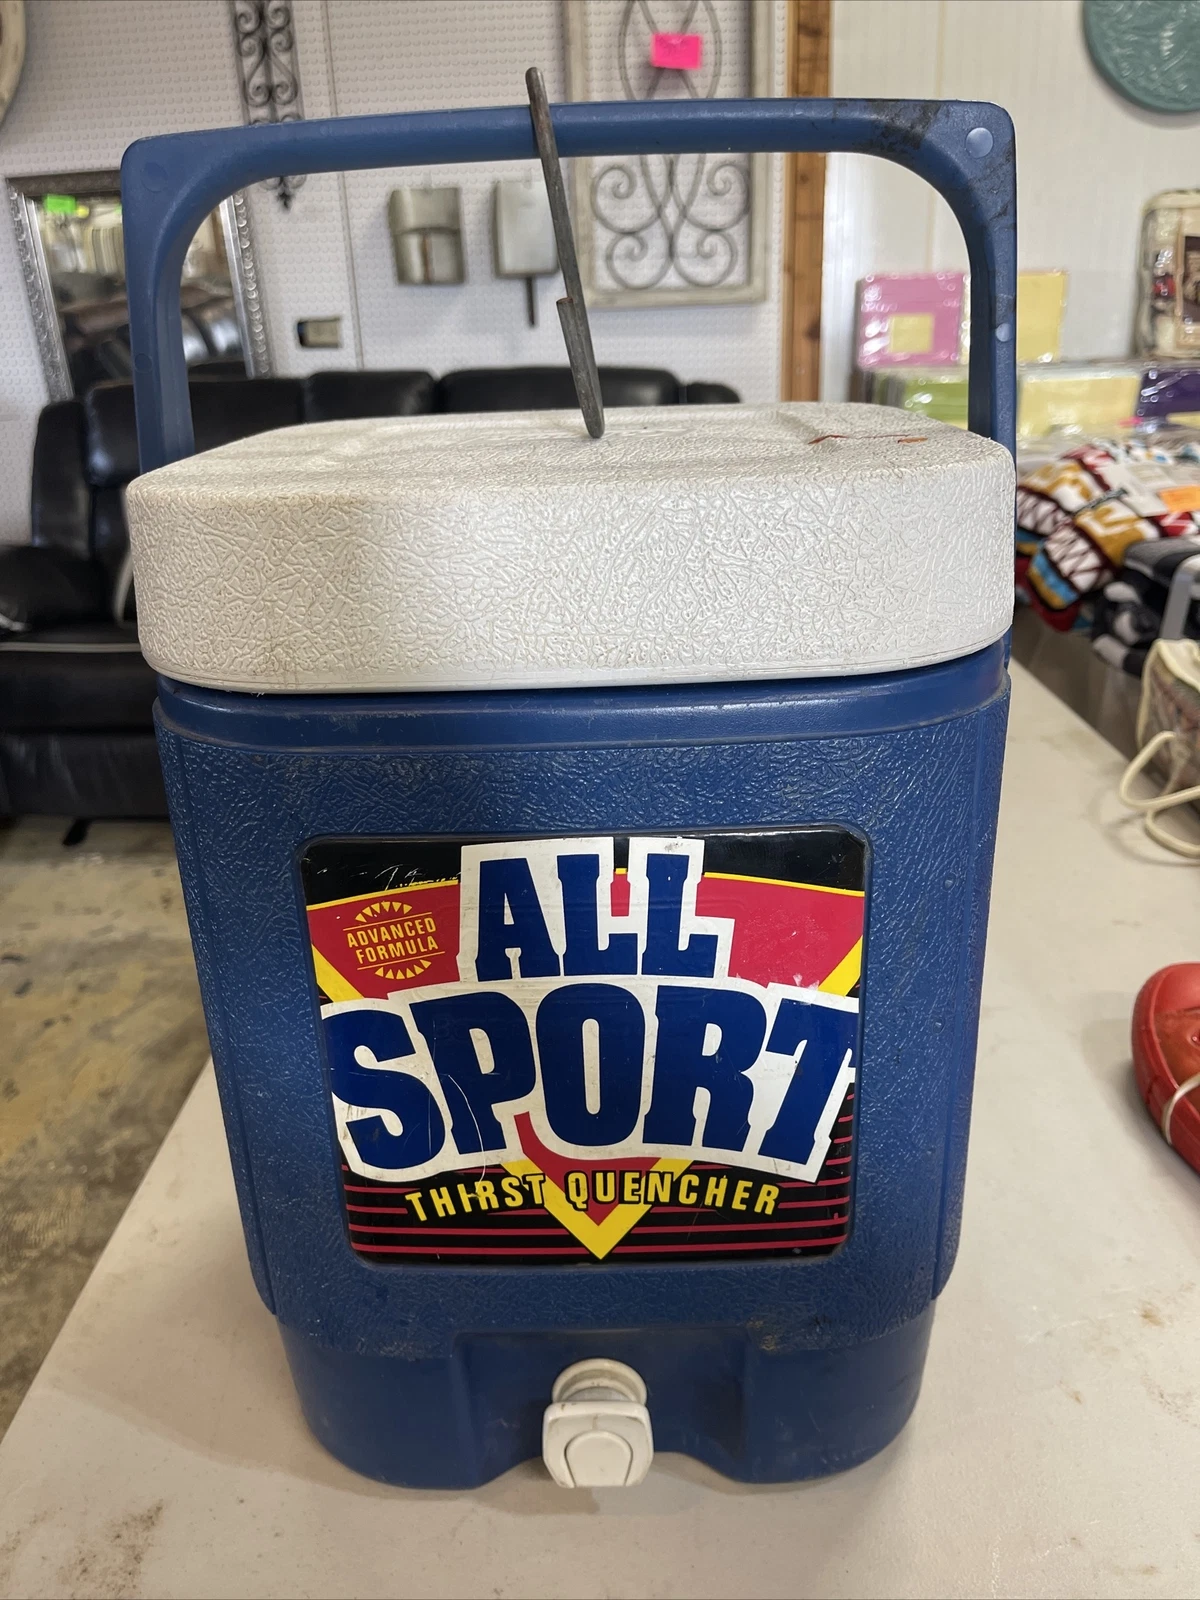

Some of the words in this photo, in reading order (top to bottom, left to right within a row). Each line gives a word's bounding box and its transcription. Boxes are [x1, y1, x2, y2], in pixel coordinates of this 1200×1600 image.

[346, 917, 437, 948] ADVANCED
[476, 853, 719, 979] ALL
[355, 935, 439, 964] FORMULA
[321, 982, 859, 1170] SPORT
[405, 1171, 548, 1223] THIRST
[567, 1168, 781, 1216] QUENCHER
